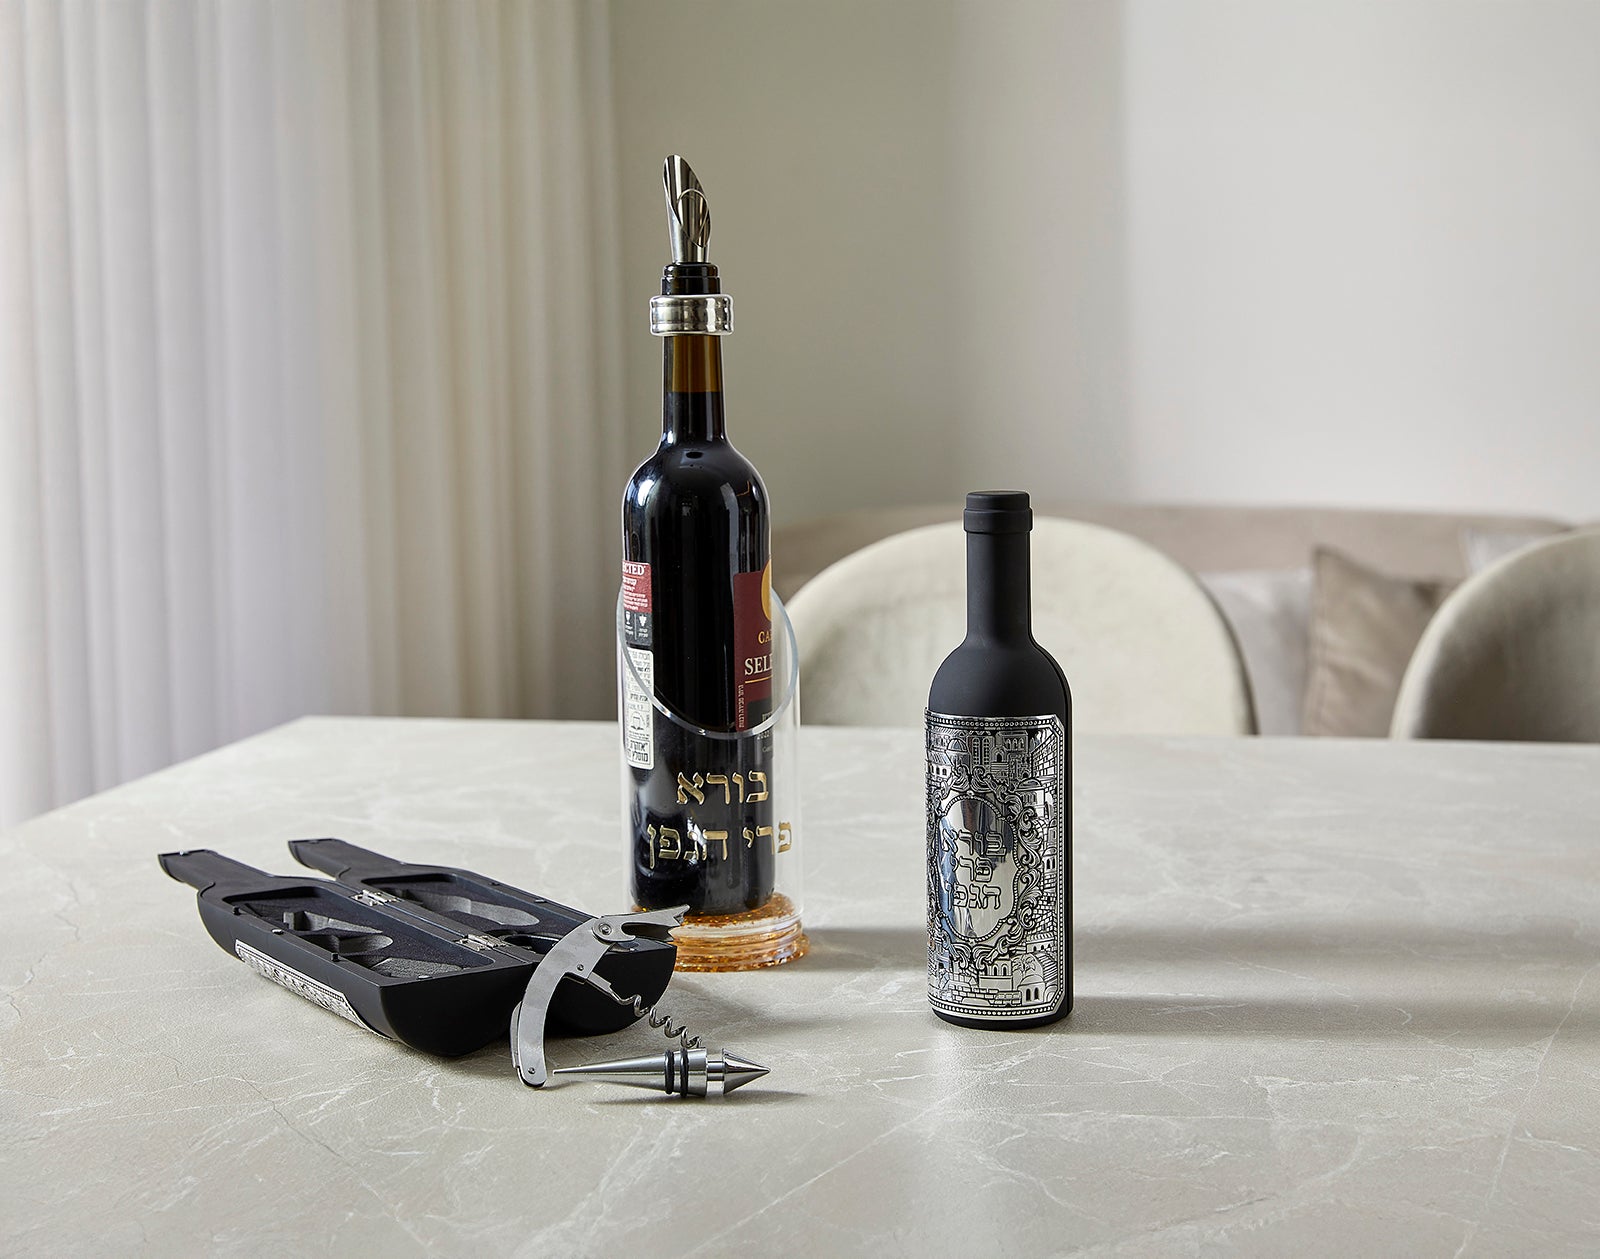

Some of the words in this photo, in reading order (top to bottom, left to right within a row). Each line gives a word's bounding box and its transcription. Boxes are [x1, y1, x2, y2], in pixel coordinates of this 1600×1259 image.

[758, 631, 772, 644] CA
[676, 770, 769, 805] בורא
[647, 823, 728, 870] הגפן
[743, 821, 792, 856] פרי
[942, 829, 1007, 857] בורא
[945, 881, 1002, 911] הגפן
